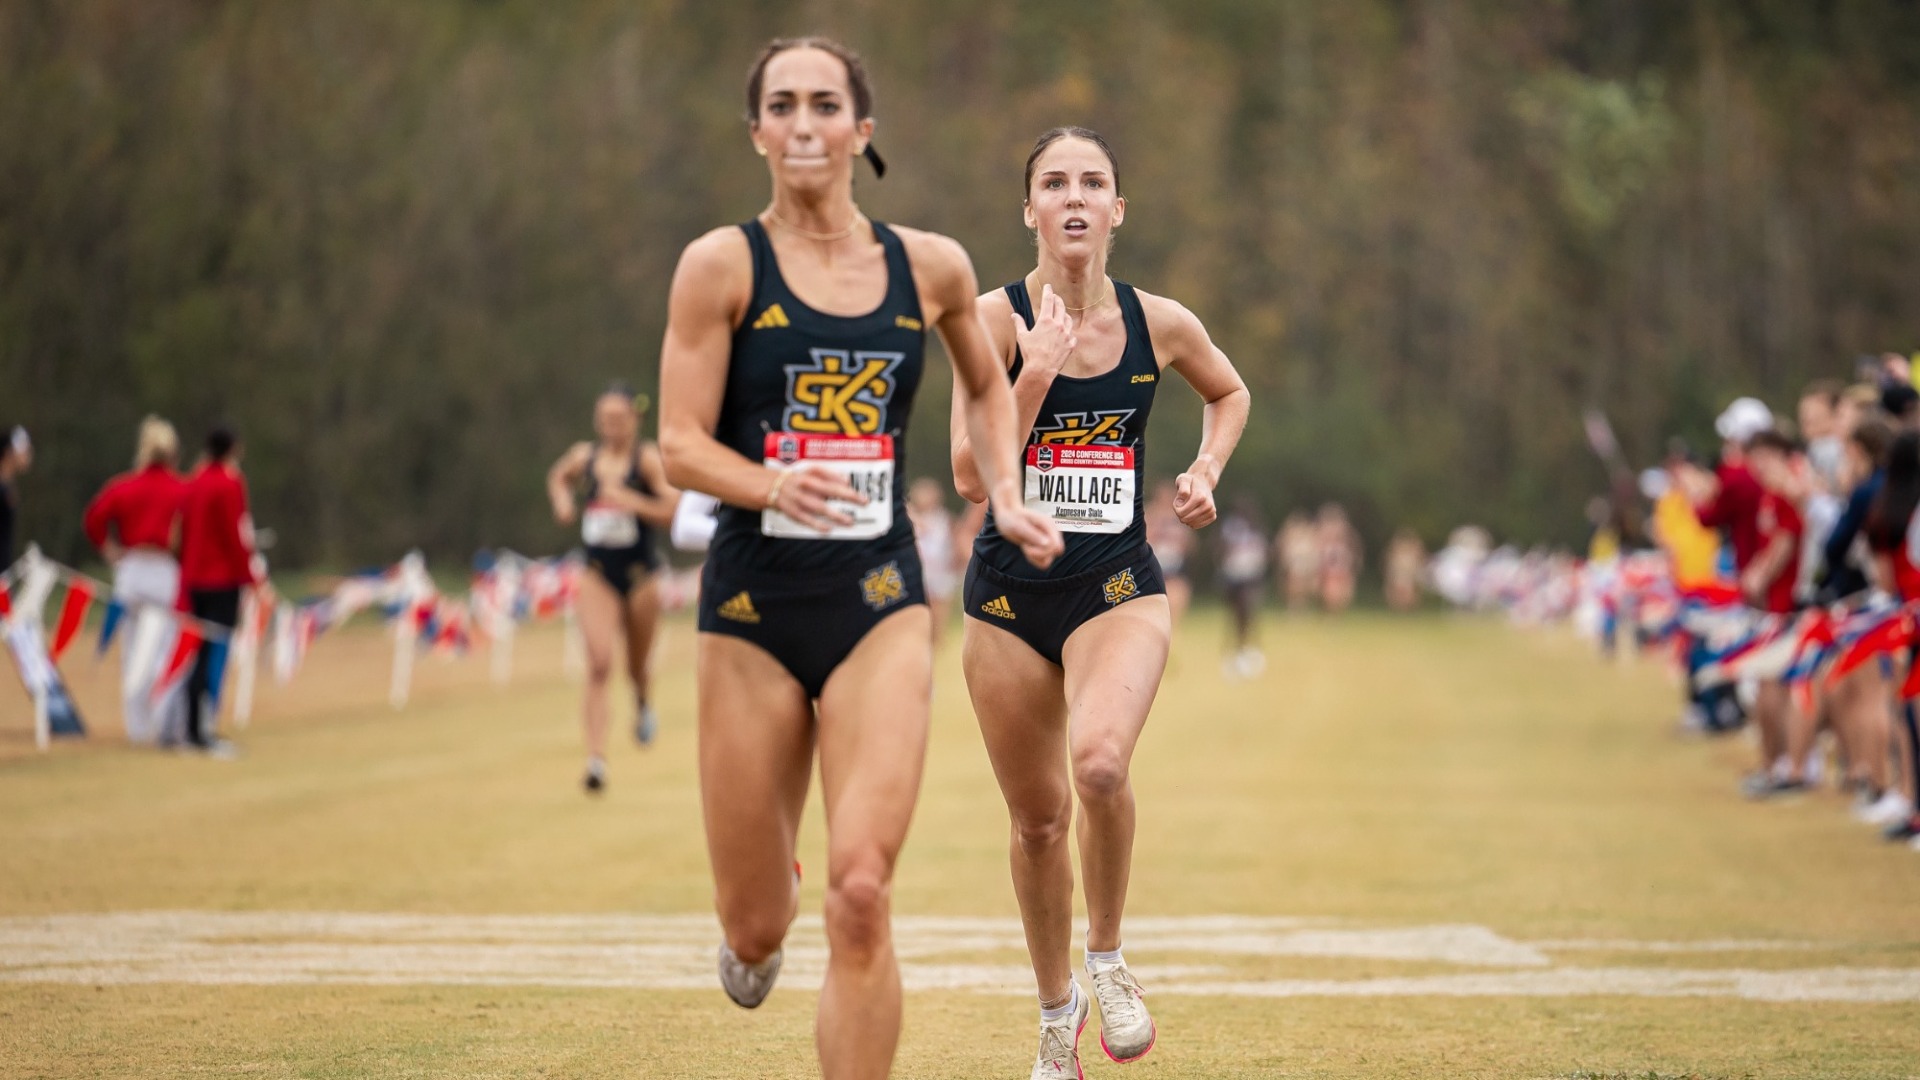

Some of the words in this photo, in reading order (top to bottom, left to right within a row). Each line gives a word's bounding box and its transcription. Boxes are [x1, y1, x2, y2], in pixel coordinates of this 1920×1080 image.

[1060, 450, 1075, 458] 2024
[1076, 450, 1113, 459] CONFERENCE
[1039, 474, 1122, 504] WALLACE
[1055, 506, 1087, 517] Kennesaw
[1088, 508, 1103, 518] State
[981, 604, 1016, 620] adidas
